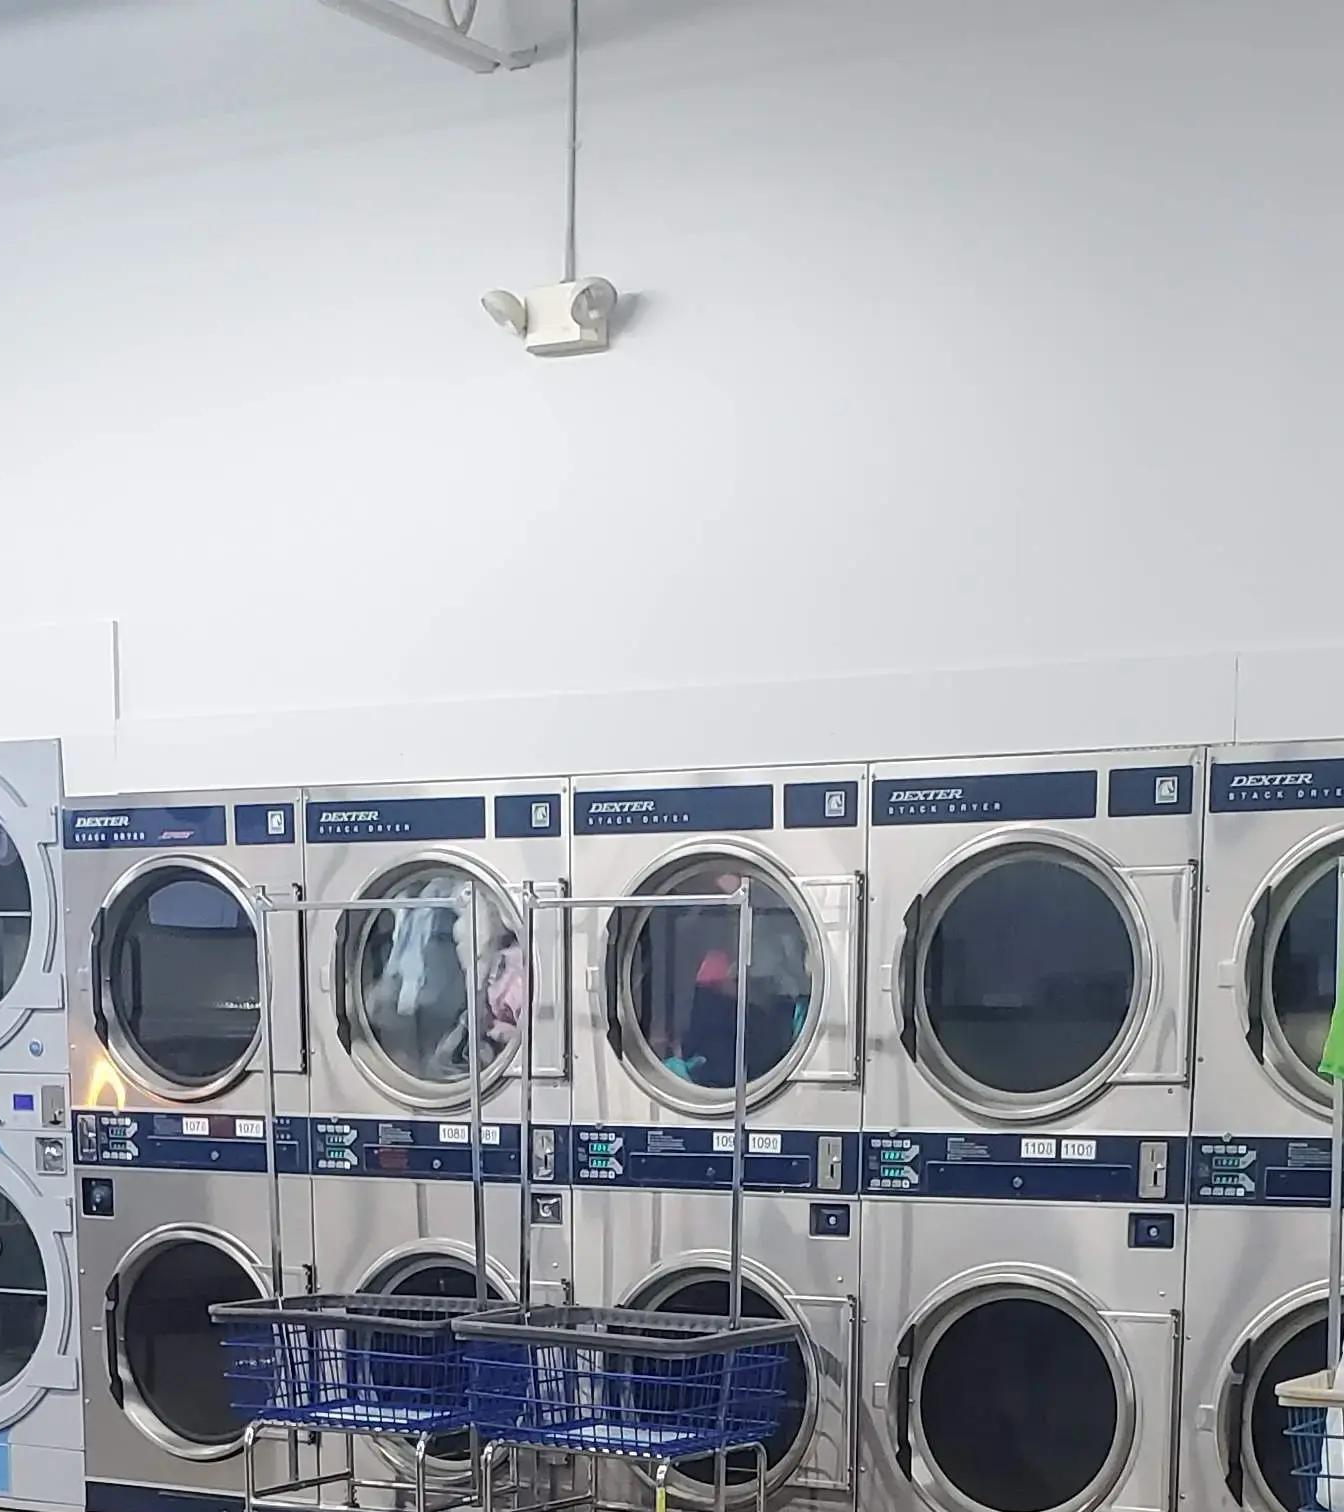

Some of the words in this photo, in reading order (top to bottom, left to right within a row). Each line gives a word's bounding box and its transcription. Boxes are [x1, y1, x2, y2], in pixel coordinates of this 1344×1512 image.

[1229, 773, 1313, 787] DEXTER
[889, 788, 964, 802] DEXTER
[1228, 790, 1284, 800] STACK
[588, 800, 656, 813] DEXTER
[75, 816, 129, 828] DEXTER
[319, 811, 379, 822] DEXTER
